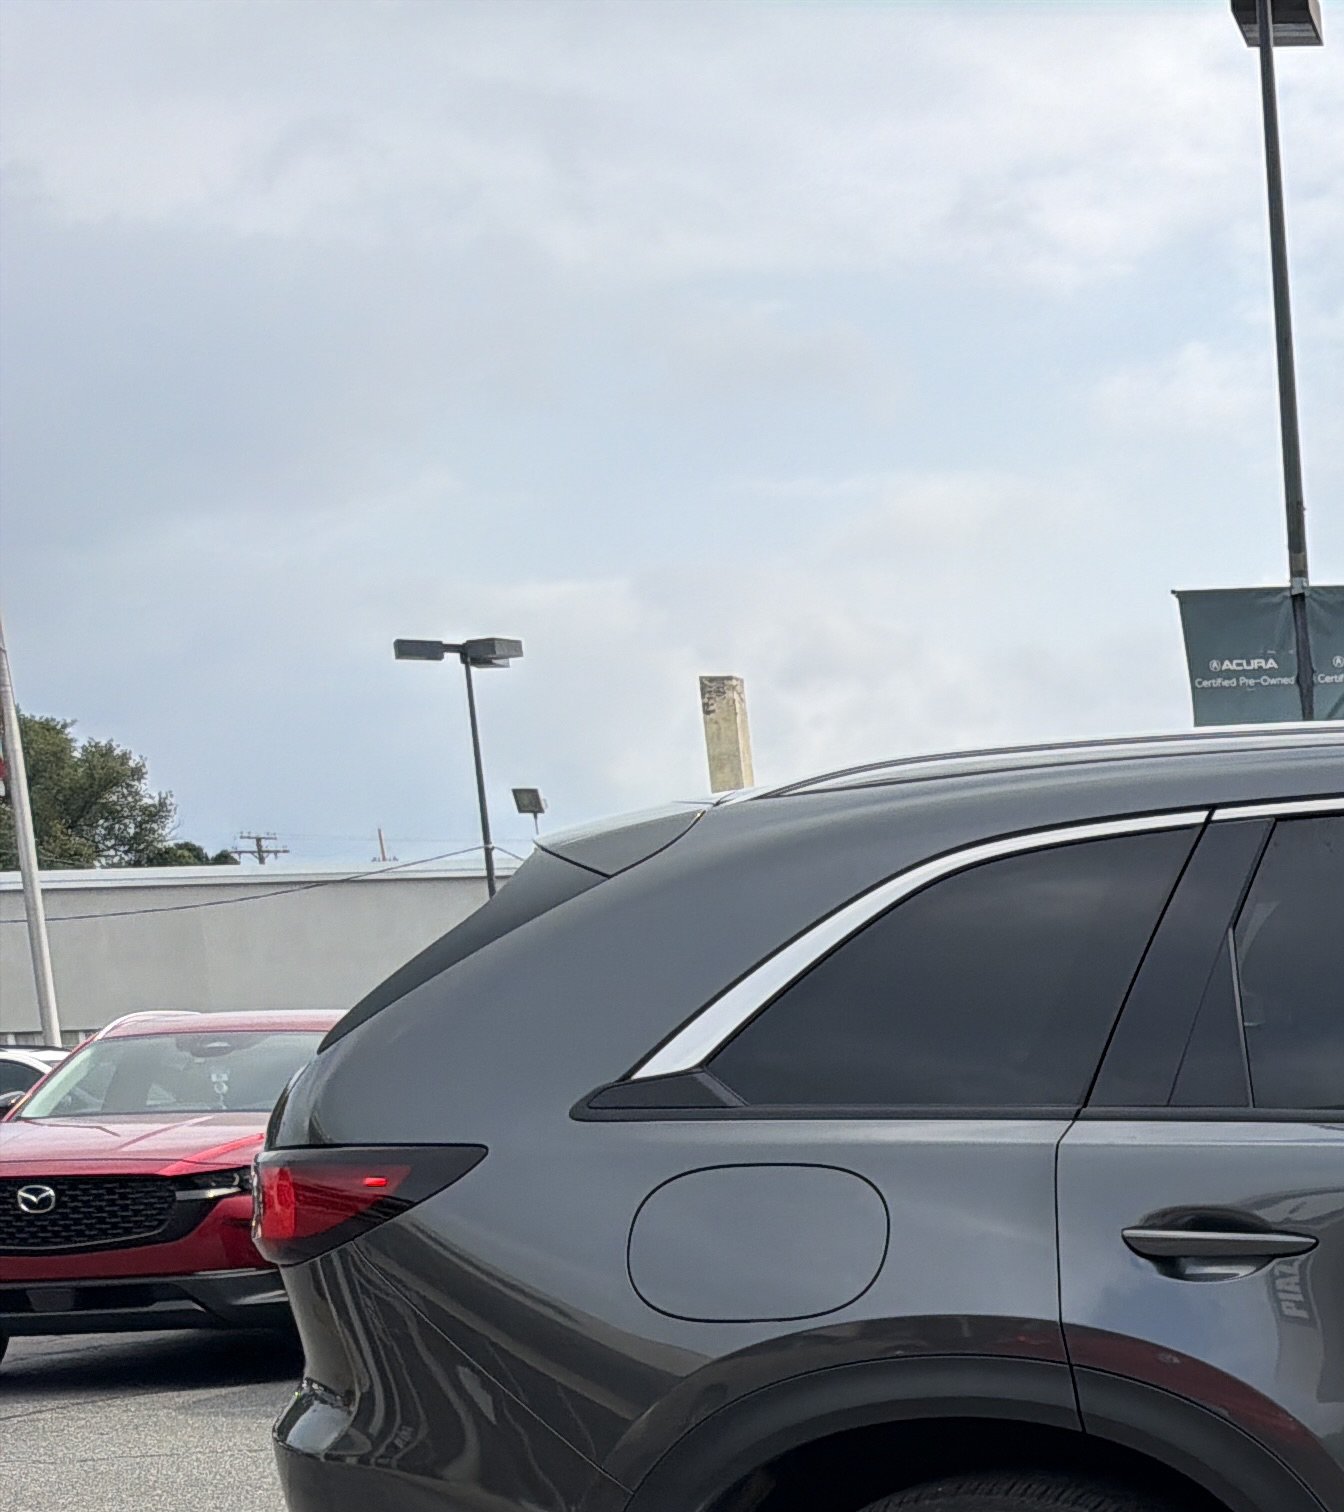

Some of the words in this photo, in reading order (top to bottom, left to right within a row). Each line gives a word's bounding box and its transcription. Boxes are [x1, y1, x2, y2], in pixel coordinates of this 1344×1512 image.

[1220, 658, 1279, 671] ACURA
[1195, 676, 1237, 689] Certified
[1239, 675, 1296, 687] Pre-Owned
